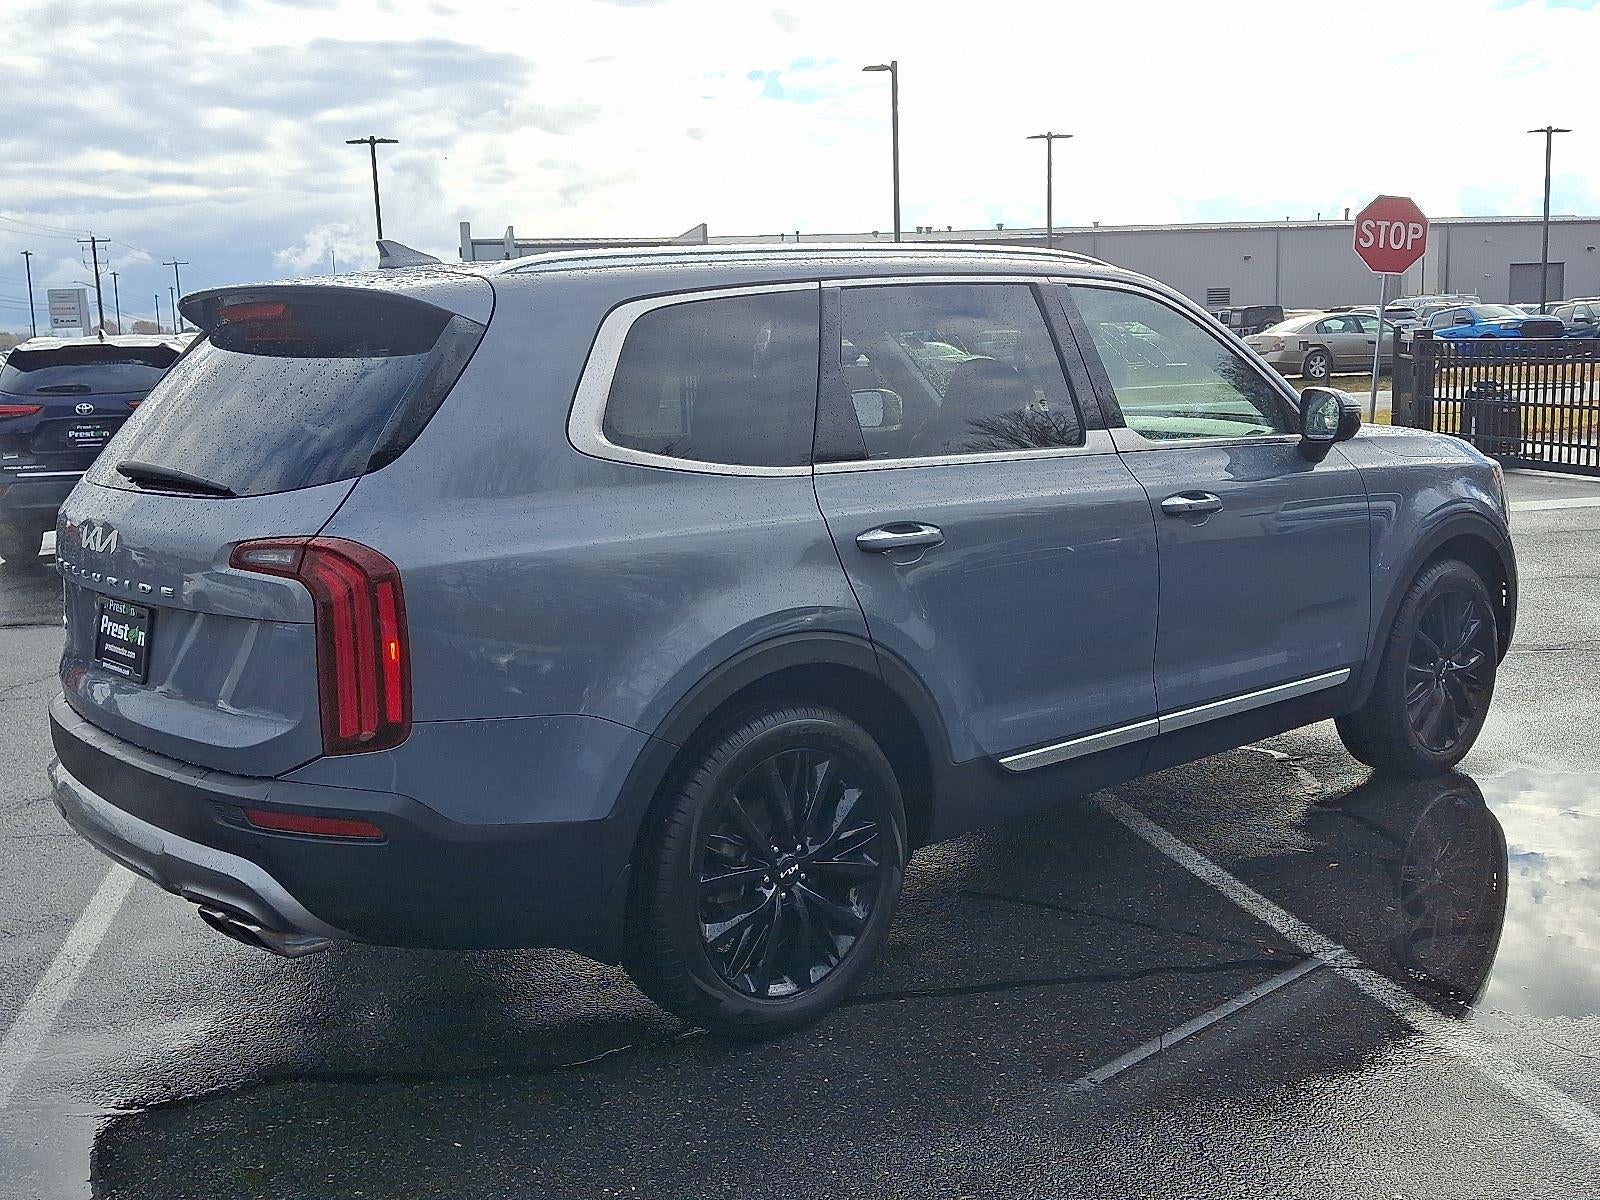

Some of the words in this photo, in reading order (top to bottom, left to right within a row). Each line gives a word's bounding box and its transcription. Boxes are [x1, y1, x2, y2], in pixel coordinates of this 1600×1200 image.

[1359, 219, 1424, 250] STOP
[68, 430, 110, 438] Preston
[81, 524, 119, 555] KIA
[108, 599, 136, 617] Preston
[100, 614, 146, 647] Preston
